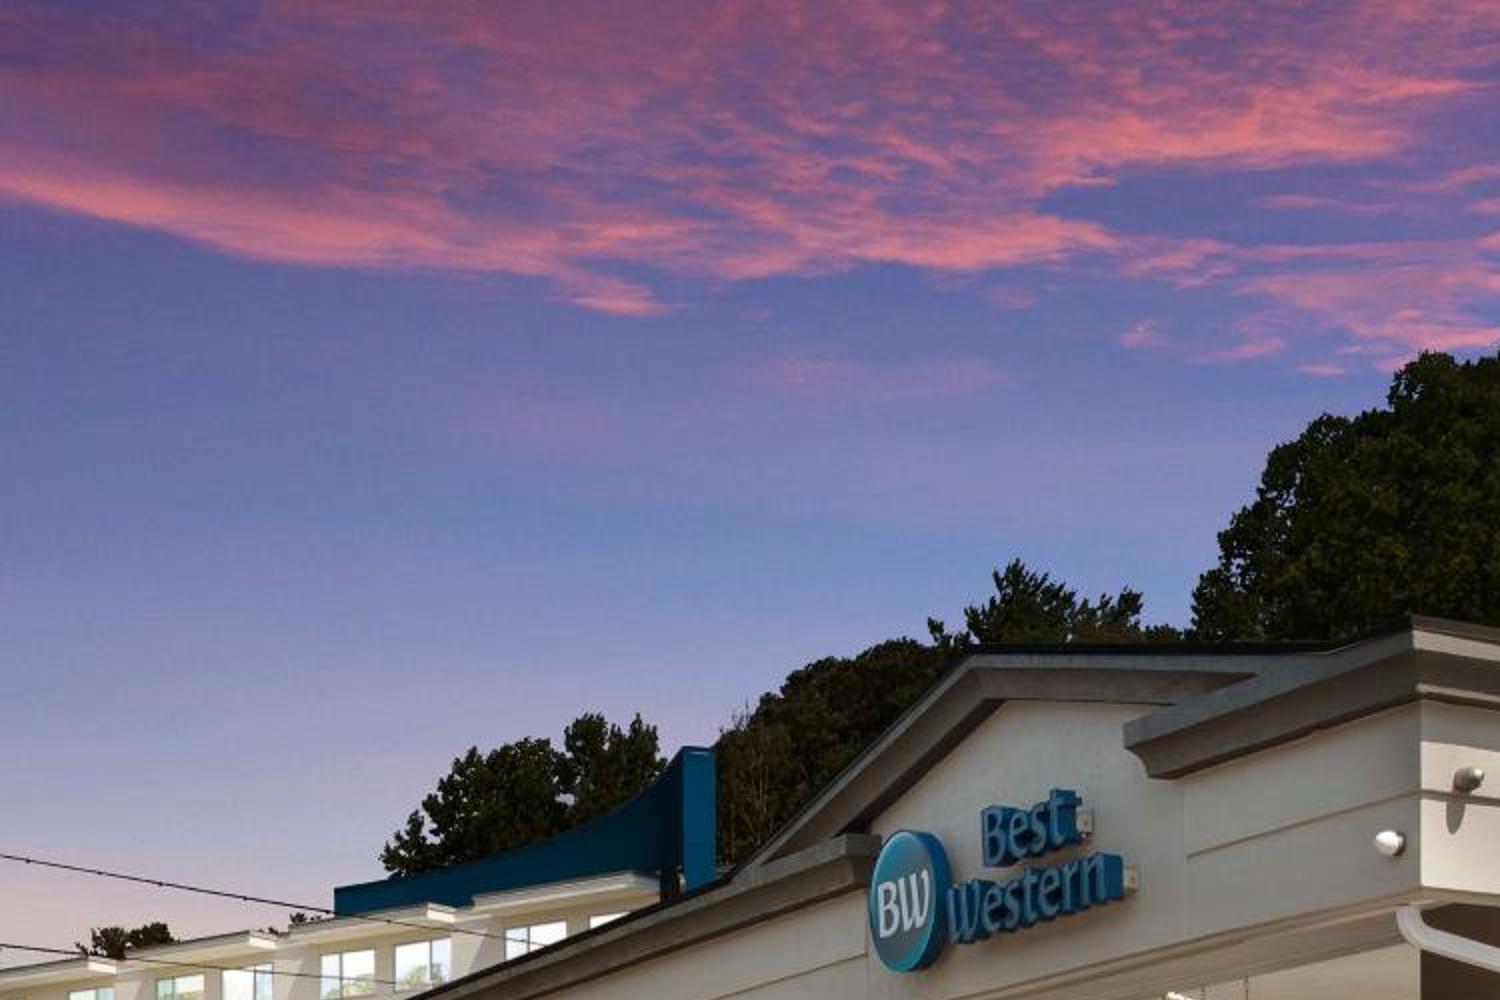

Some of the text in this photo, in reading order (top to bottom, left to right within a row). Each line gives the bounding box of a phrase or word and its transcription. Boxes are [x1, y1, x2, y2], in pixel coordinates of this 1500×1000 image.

[981, 790, 1081, 867] Best
[877, 868, 930, 939] BW
[948, 853, 1121, 944] Western
